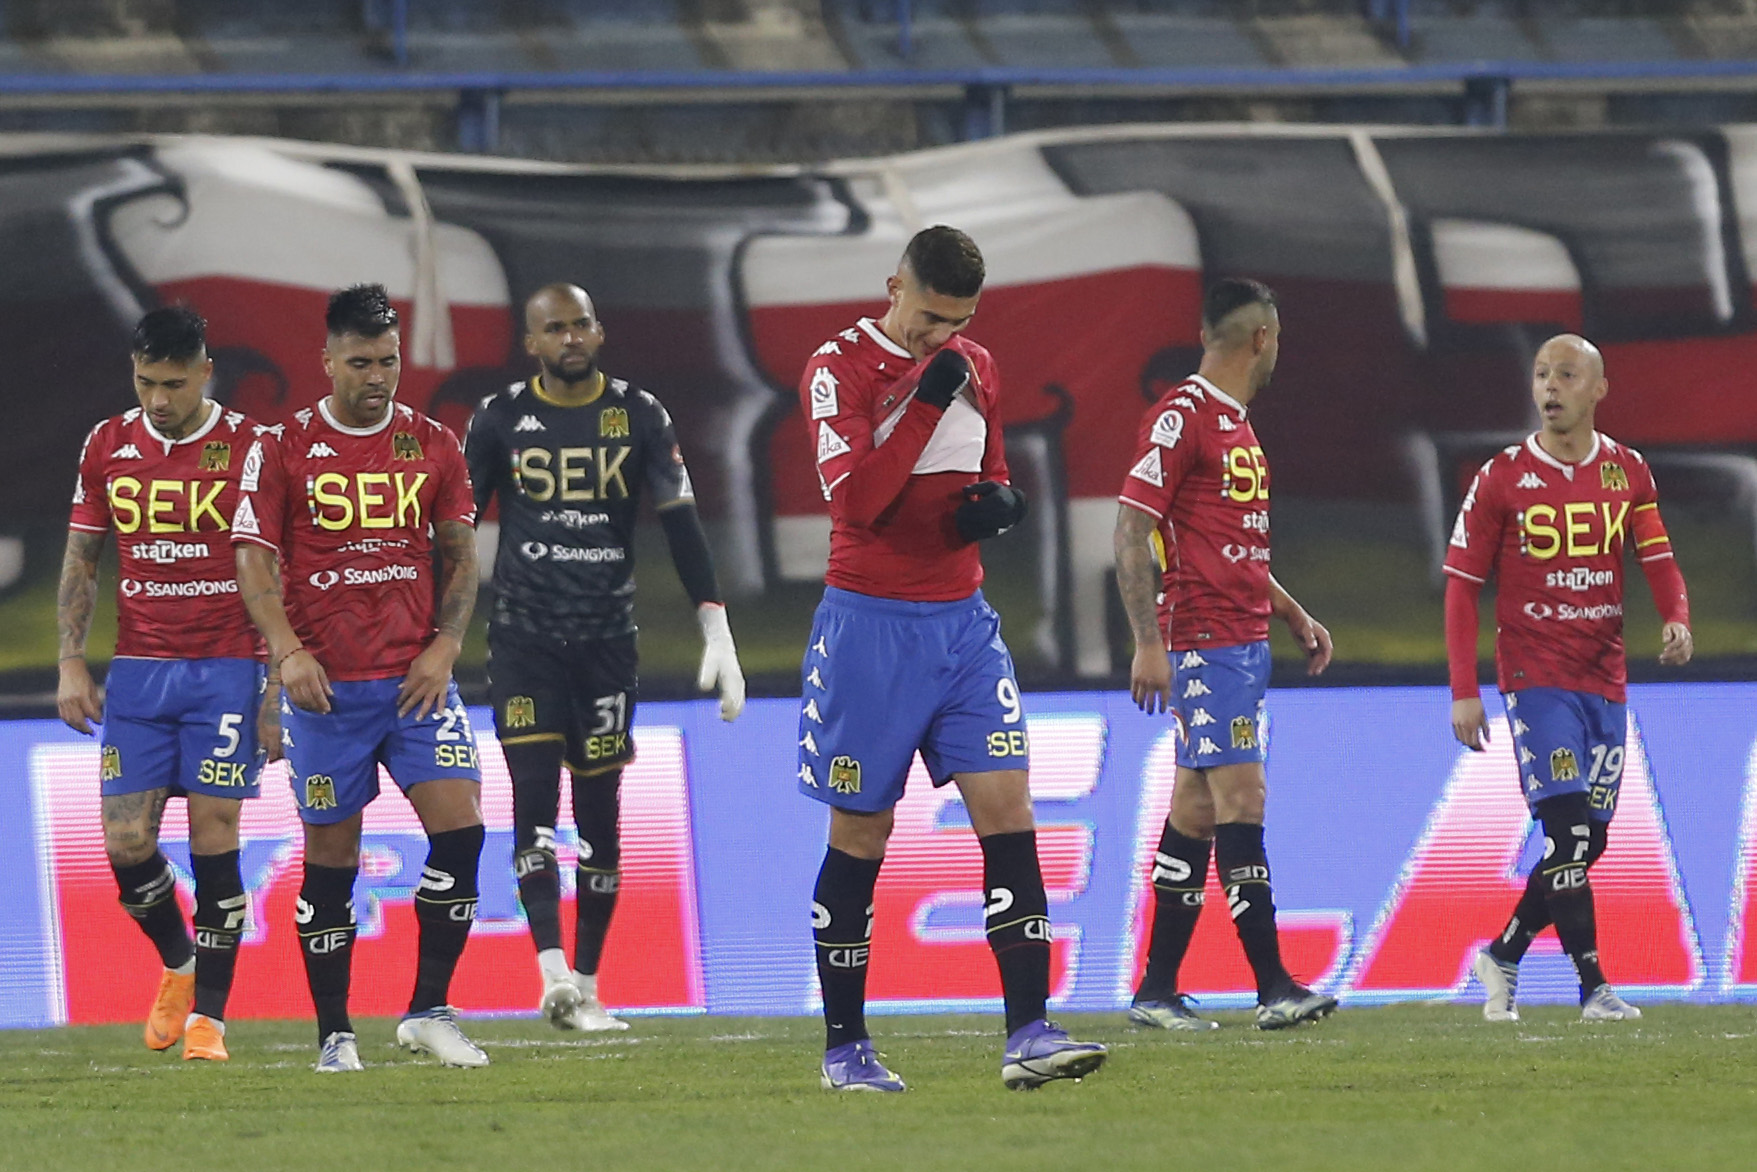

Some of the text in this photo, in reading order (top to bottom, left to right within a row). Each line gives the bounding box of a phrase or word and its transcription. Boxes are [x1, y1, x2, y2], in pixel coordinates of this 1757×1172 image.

[519, 446, 632, 501] SEK
[1228, 446, 1269, 502] SE
[111, 476, 230, 533] SEK
[314, 472, 429, 530] SEK
[1524, 501, 1630, 559] SEK
[132, 540, 209, 563] starken
[145, 580, 238, 596] SSANGYONG
[1546, 567, 1613, 591] starken
[592, 692, 627, 735] 31
[997, 677, 1020, 723] 9
[213, 713, 243, 757] 5
[432, 704, 472, 742] 21
[586, 734, 626, 760] SEK
[1589, 744, 1625, 784] 19
[200, 759, 247, 787] SEK
[1590, 785, 1617, 810] EK
